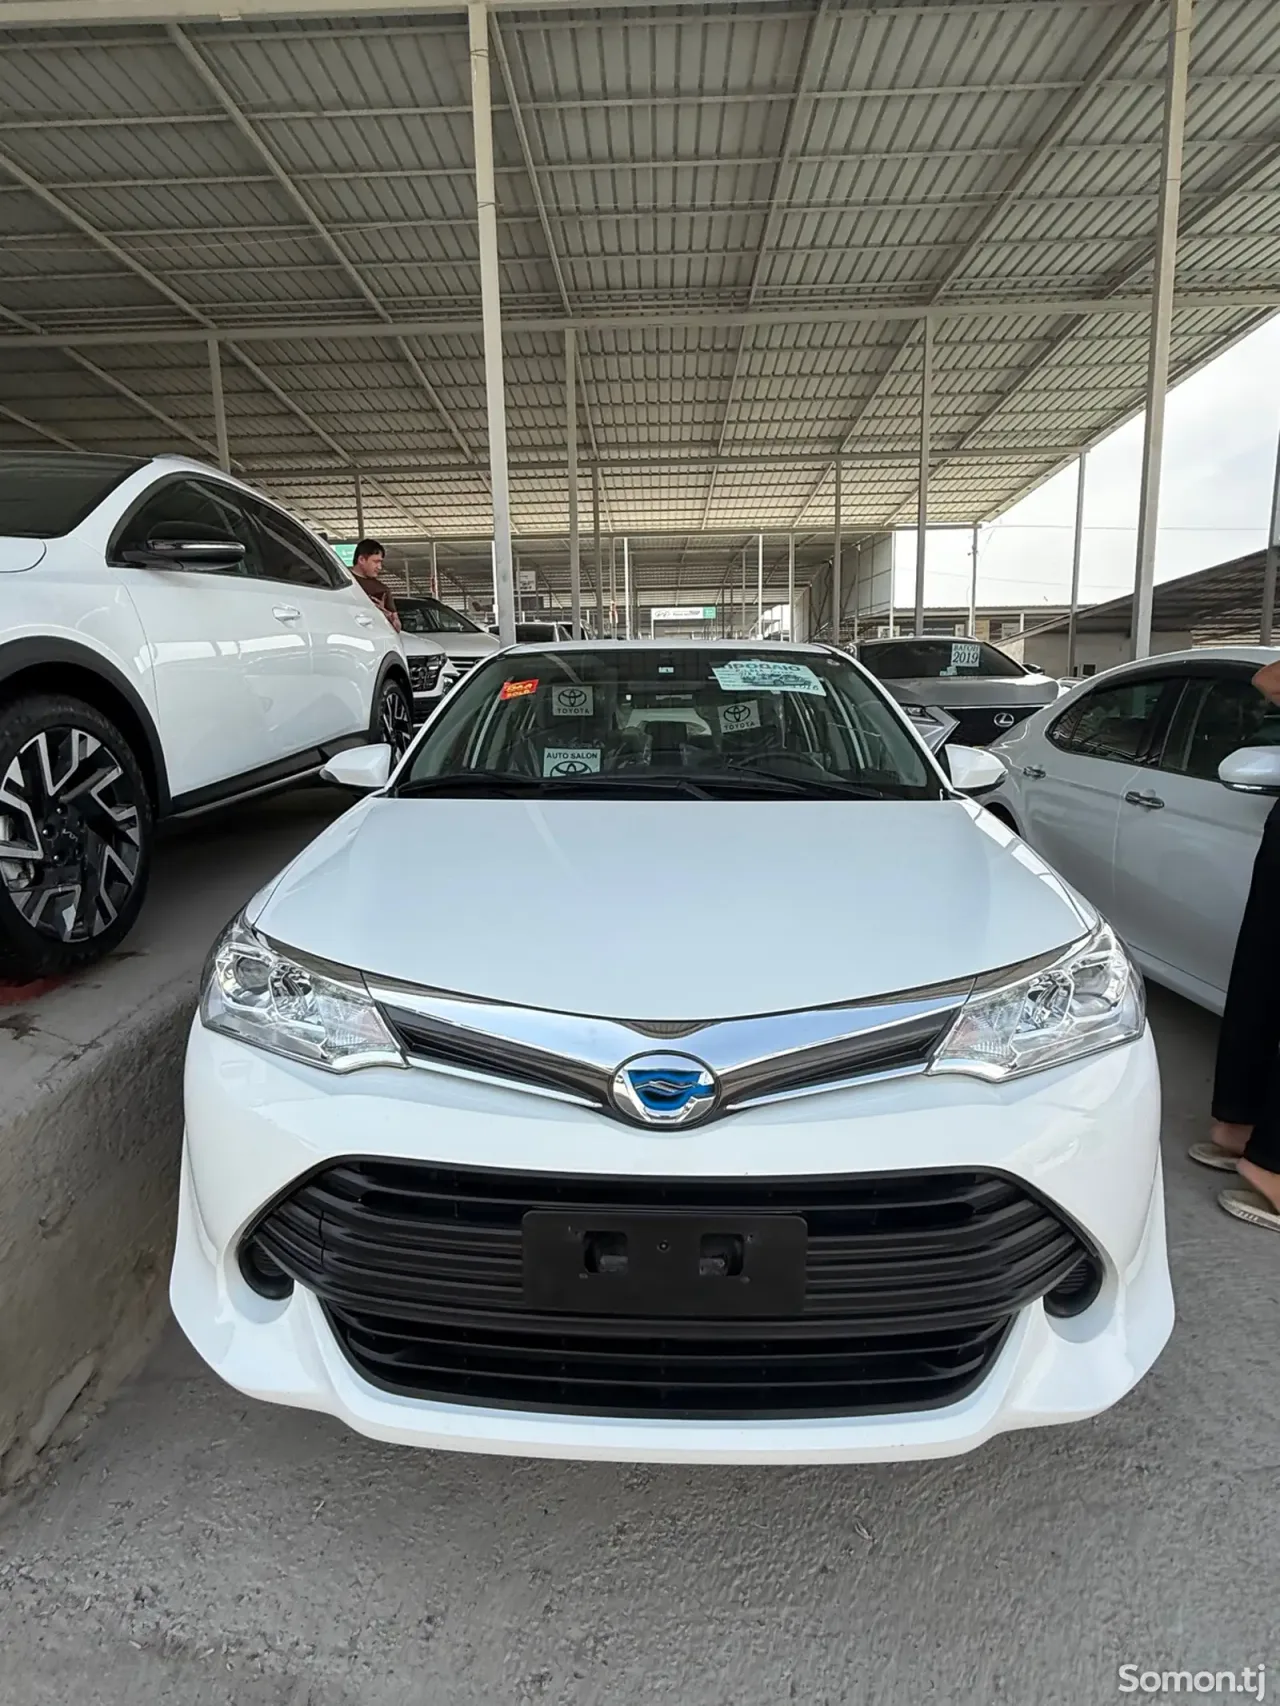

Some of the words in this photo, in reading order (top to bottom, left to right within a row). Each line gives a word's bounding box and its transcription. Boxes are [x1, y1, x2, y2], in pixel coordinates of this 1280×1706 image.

[952, 651, 979, 664] 2019
[723, 721, 755, 731] TOYOTA
[570, 752, 598, 760] SALON
